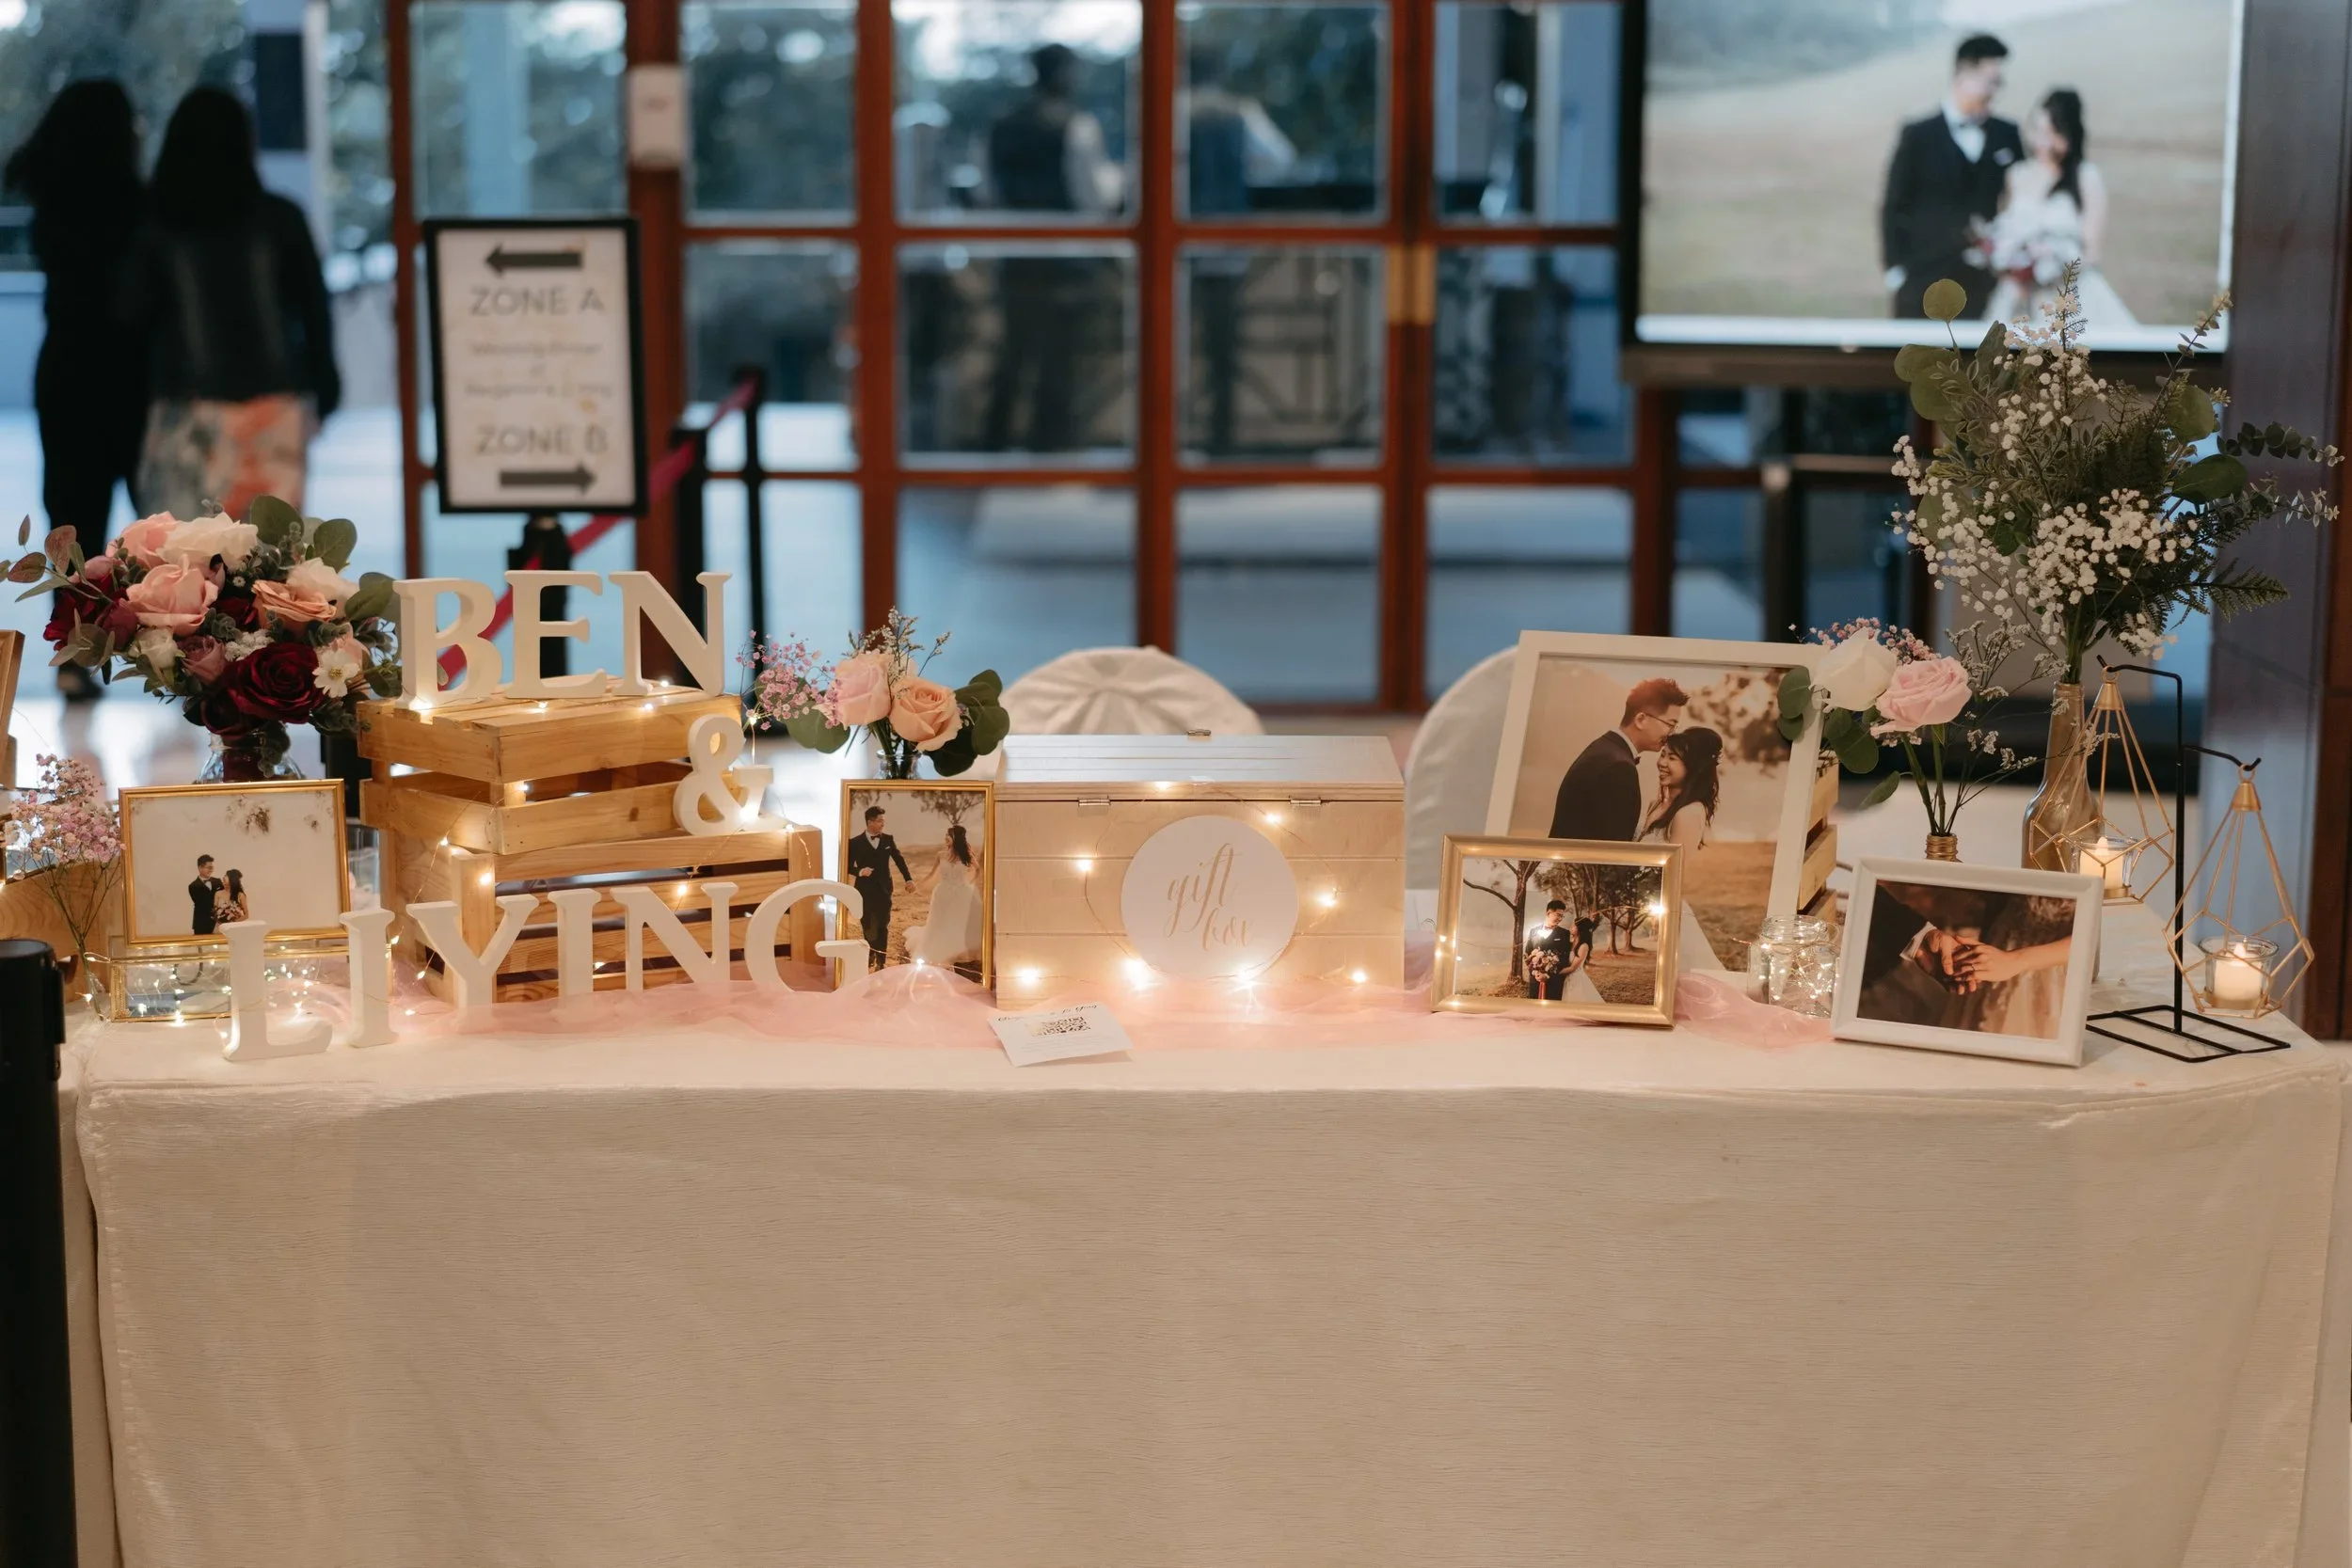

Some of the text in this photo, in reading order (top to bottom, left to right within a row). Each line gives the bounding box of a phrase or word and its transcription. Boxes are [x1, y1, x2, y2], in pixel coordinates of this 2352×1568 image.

[469, 285, 607, 316] ZONE A
[476, 422, 610, 455] ZONE B
[393, 570, 732, 710] BEN
[673, 714, 788, 836] &
[1164, 843, 1244, 939] gift
